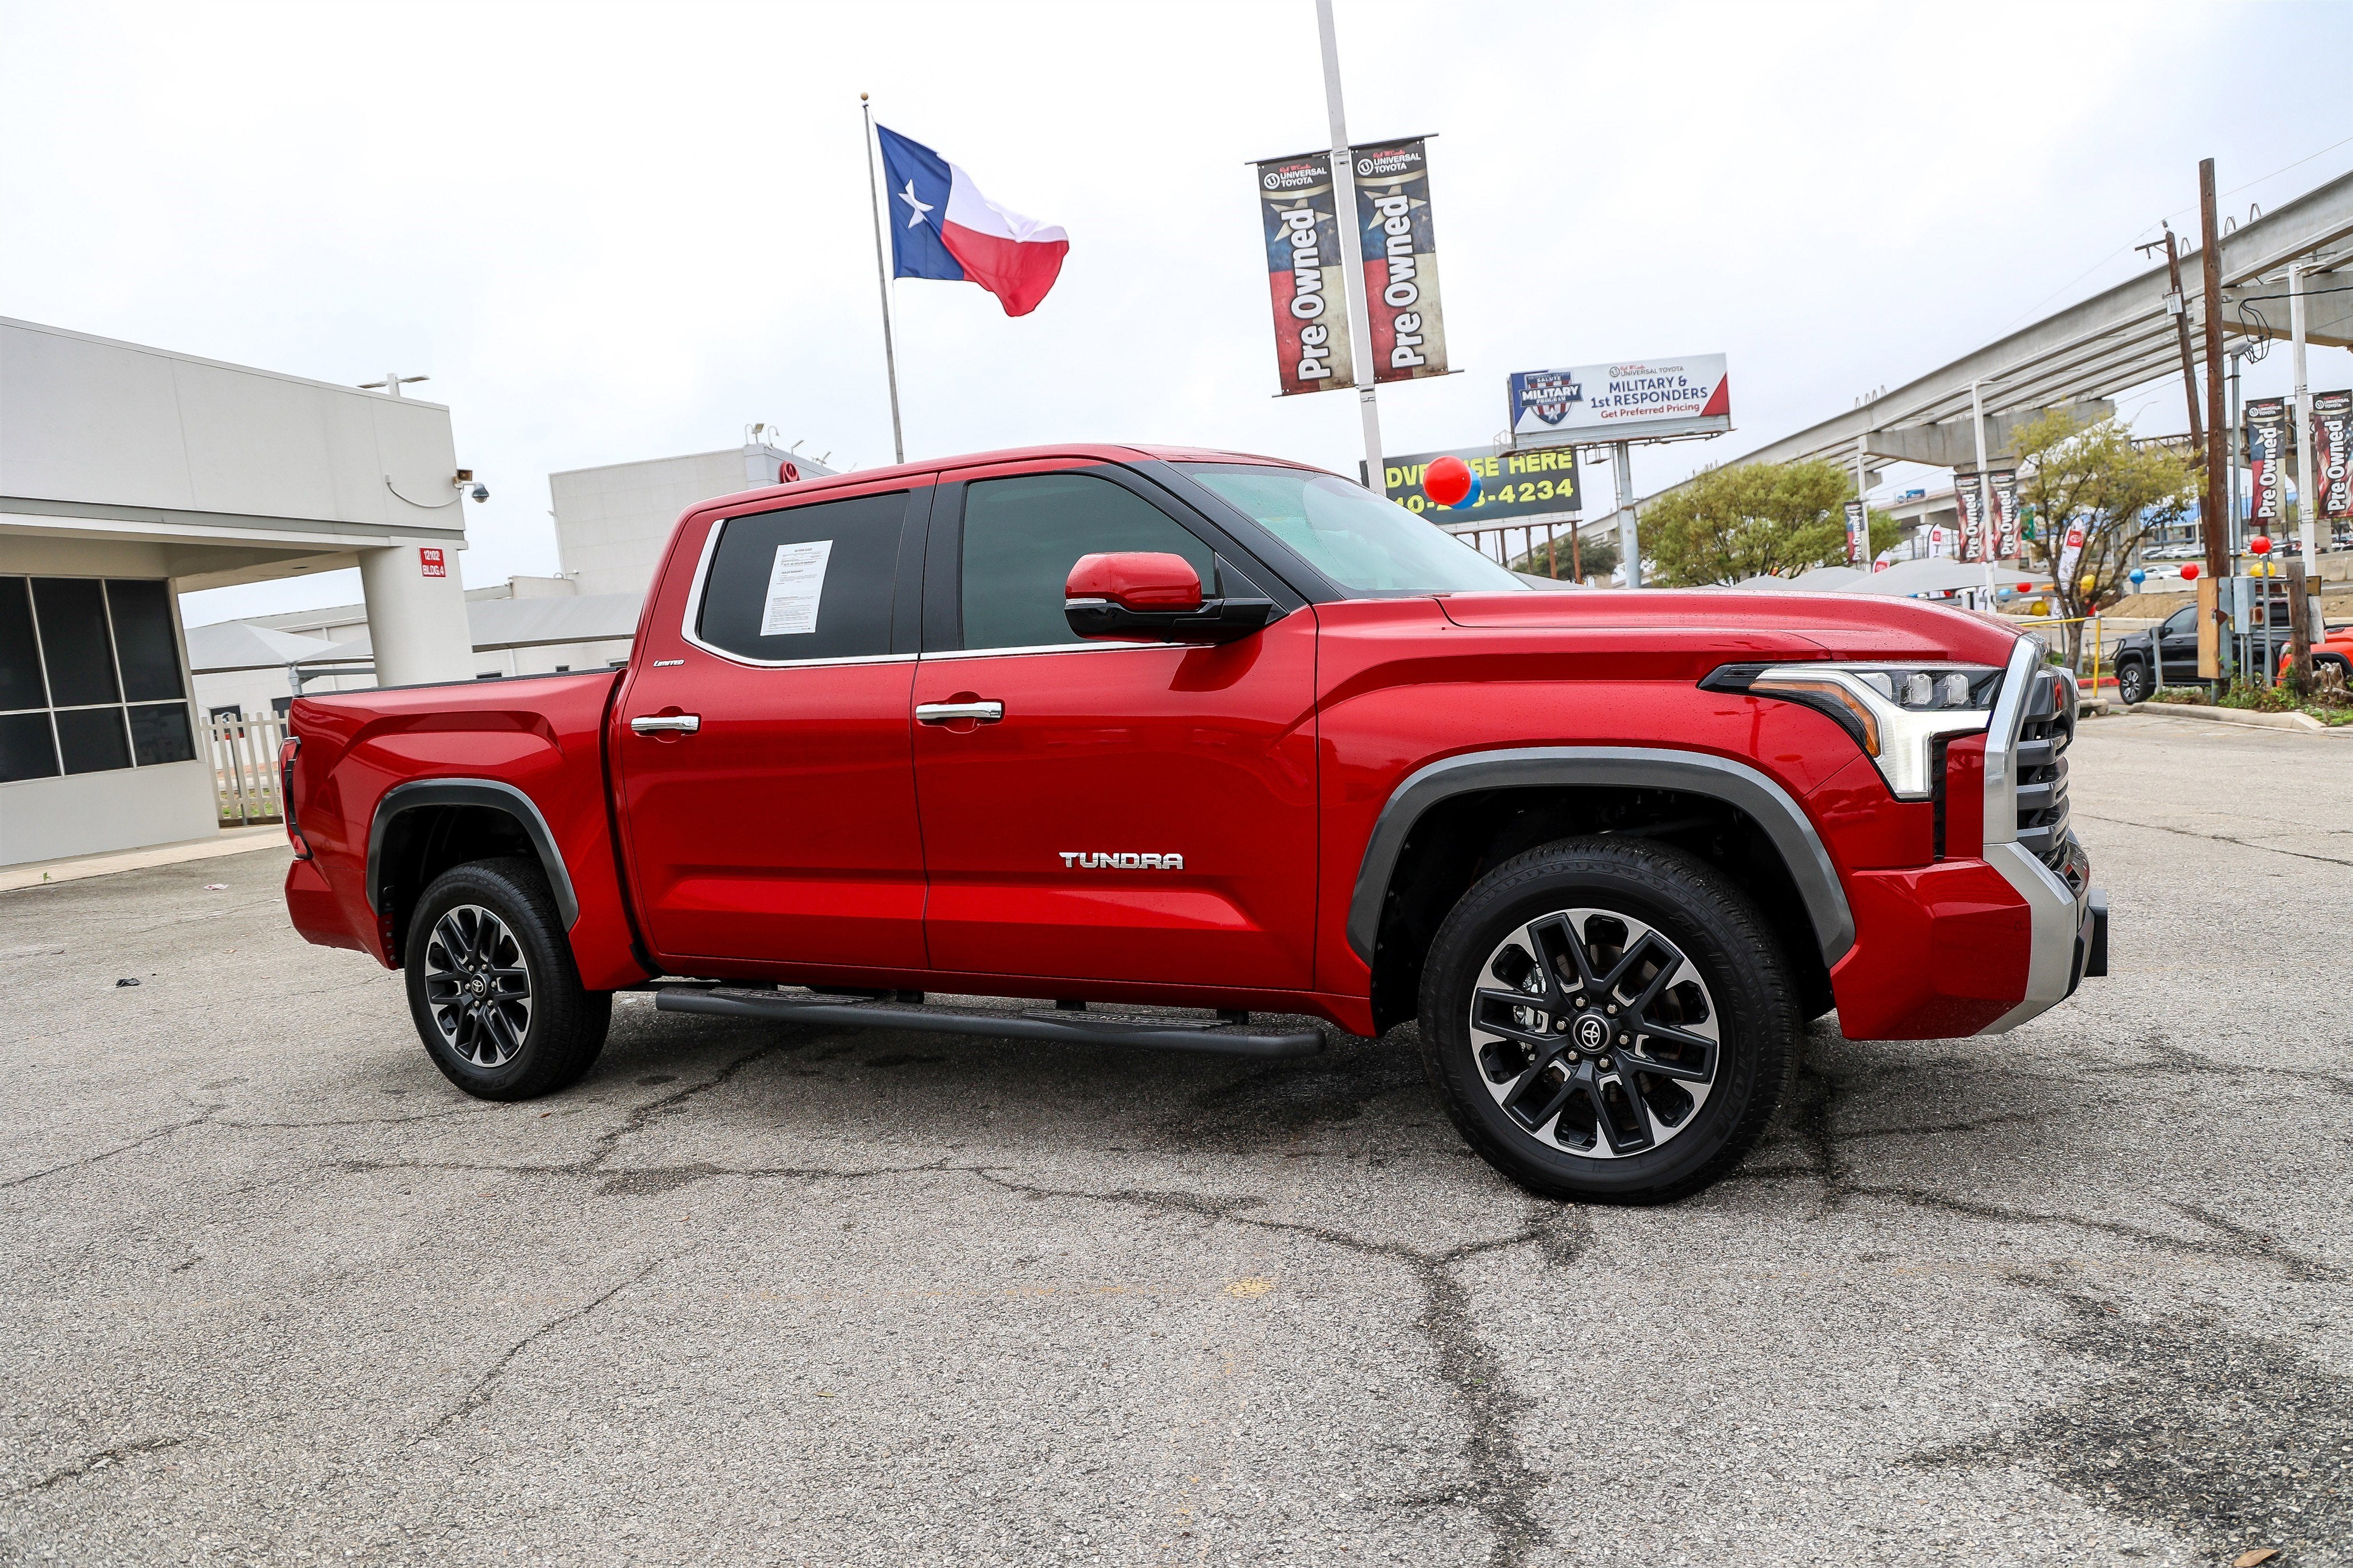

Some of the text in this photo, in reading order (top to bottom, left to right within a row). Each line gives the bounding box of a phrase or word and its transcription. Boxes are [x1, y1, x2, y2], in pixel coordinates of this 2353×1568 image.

[1374, 152, 1422, 166] UNIVERSAL
[1374, 162, 1407, 174] TOYOTA
[1280, 167, 1328, 180] UNIVERSAL
[1280, 176, 1313, 188] TOYOTA
[1374, 195, 1425, 369] Pre Owned
[1280, 208, 1331, 381] Pre Owned
[1621, 369, 1658, 377] UNIVERSAL
[1522, 385, 1579, 401] MILITARY
[1609, 375, 1688, 393] MILITARY &
[1591, 386, 1708, 408] 1st RESPONDERS
[1601, 403, 1700, 419] Get Preferred Pricing
[2258, 426, 2277, 486] Owned
[2324, 420, 2345, 478] Owned
[1509, 447, 1573, 474] HERE
[2258, 489, 2277, 518] Pre
[2328, 481, 2346, 511] Pre
[1962, 493, 1978, 536] Owned
[1996, 490, 2013, 533] Owned
[1850, 515, 1861, 546] Owned
[1966, 537, 1980, 558] Pre
[2000, 534, 2015, 555] Pre
[423, 550, 441, 561] 12102
[1059, 852, 1183, 869] TUNDRA
